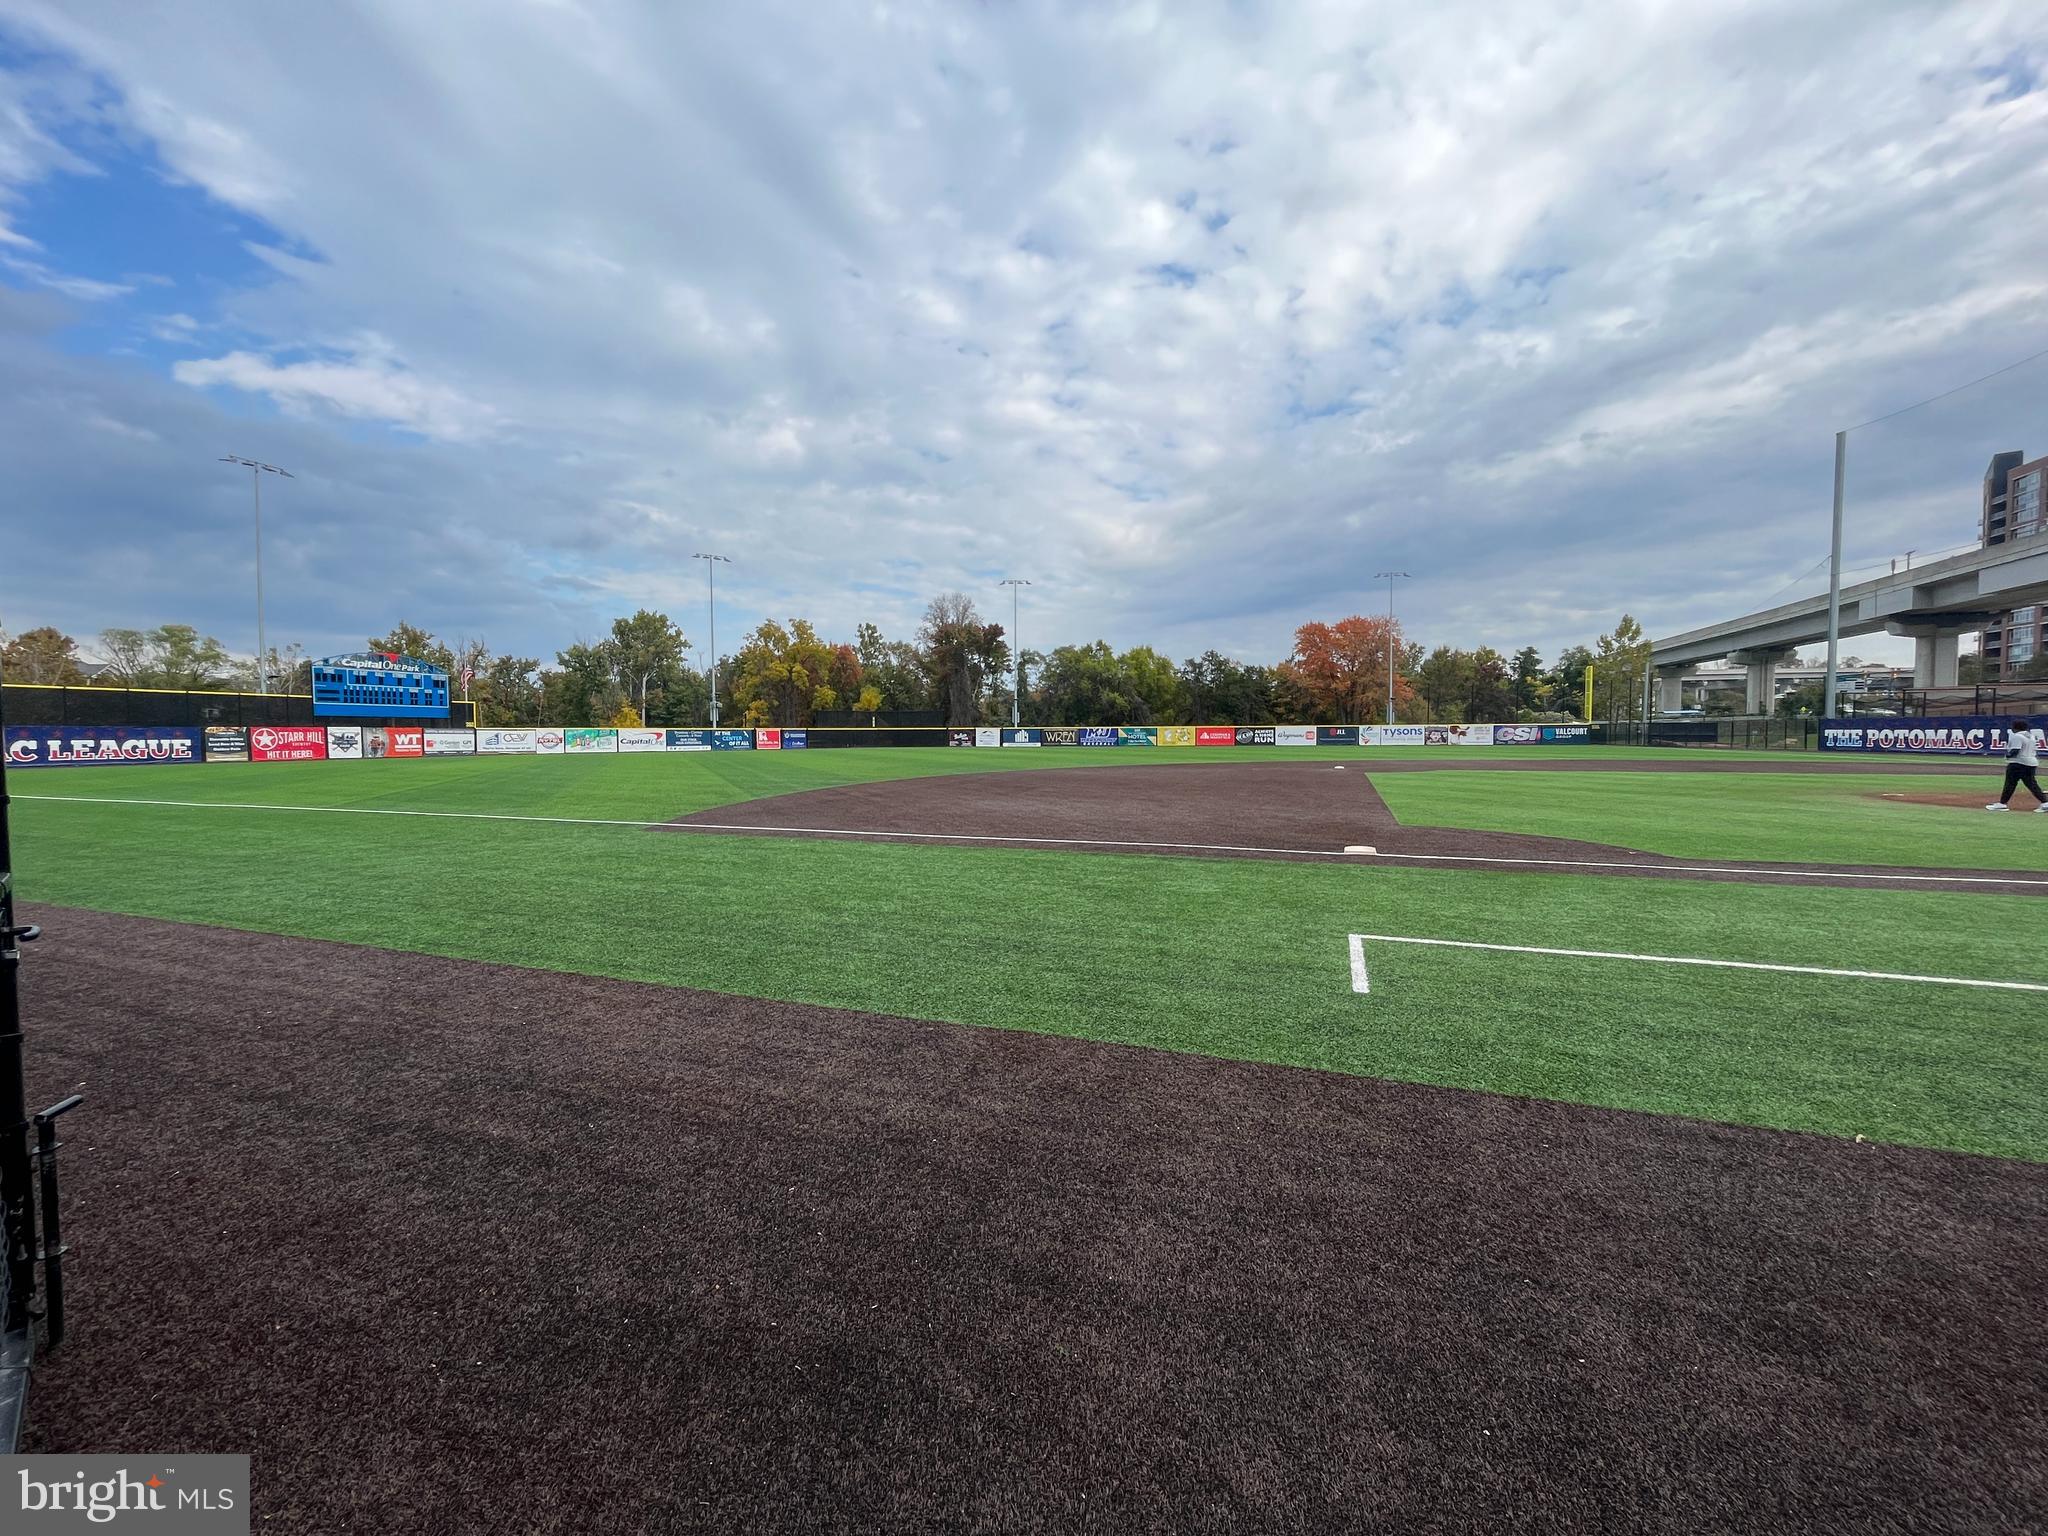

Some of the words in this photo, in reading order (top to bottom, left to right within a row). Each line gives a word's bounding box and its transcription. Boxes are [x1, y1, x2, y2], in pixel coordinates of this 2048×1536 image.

[402, 664, 420, 672] Park
[278, 731, 305, 745] STARR
[307, 731, 324, 744] HILL
[394, 733, 422, 745] WT
[1496, 727, 1538, 741] CSI
[1824, 729, 1863, 747] THE
[1866, 728, 1985, 750] POTOMAC
[620, 737, 650, 746] Capital
[47, 739, 192, 761] LEAGUE
[267, 751, 280, 759] HIT
[282, 751, 289, 759] IT
